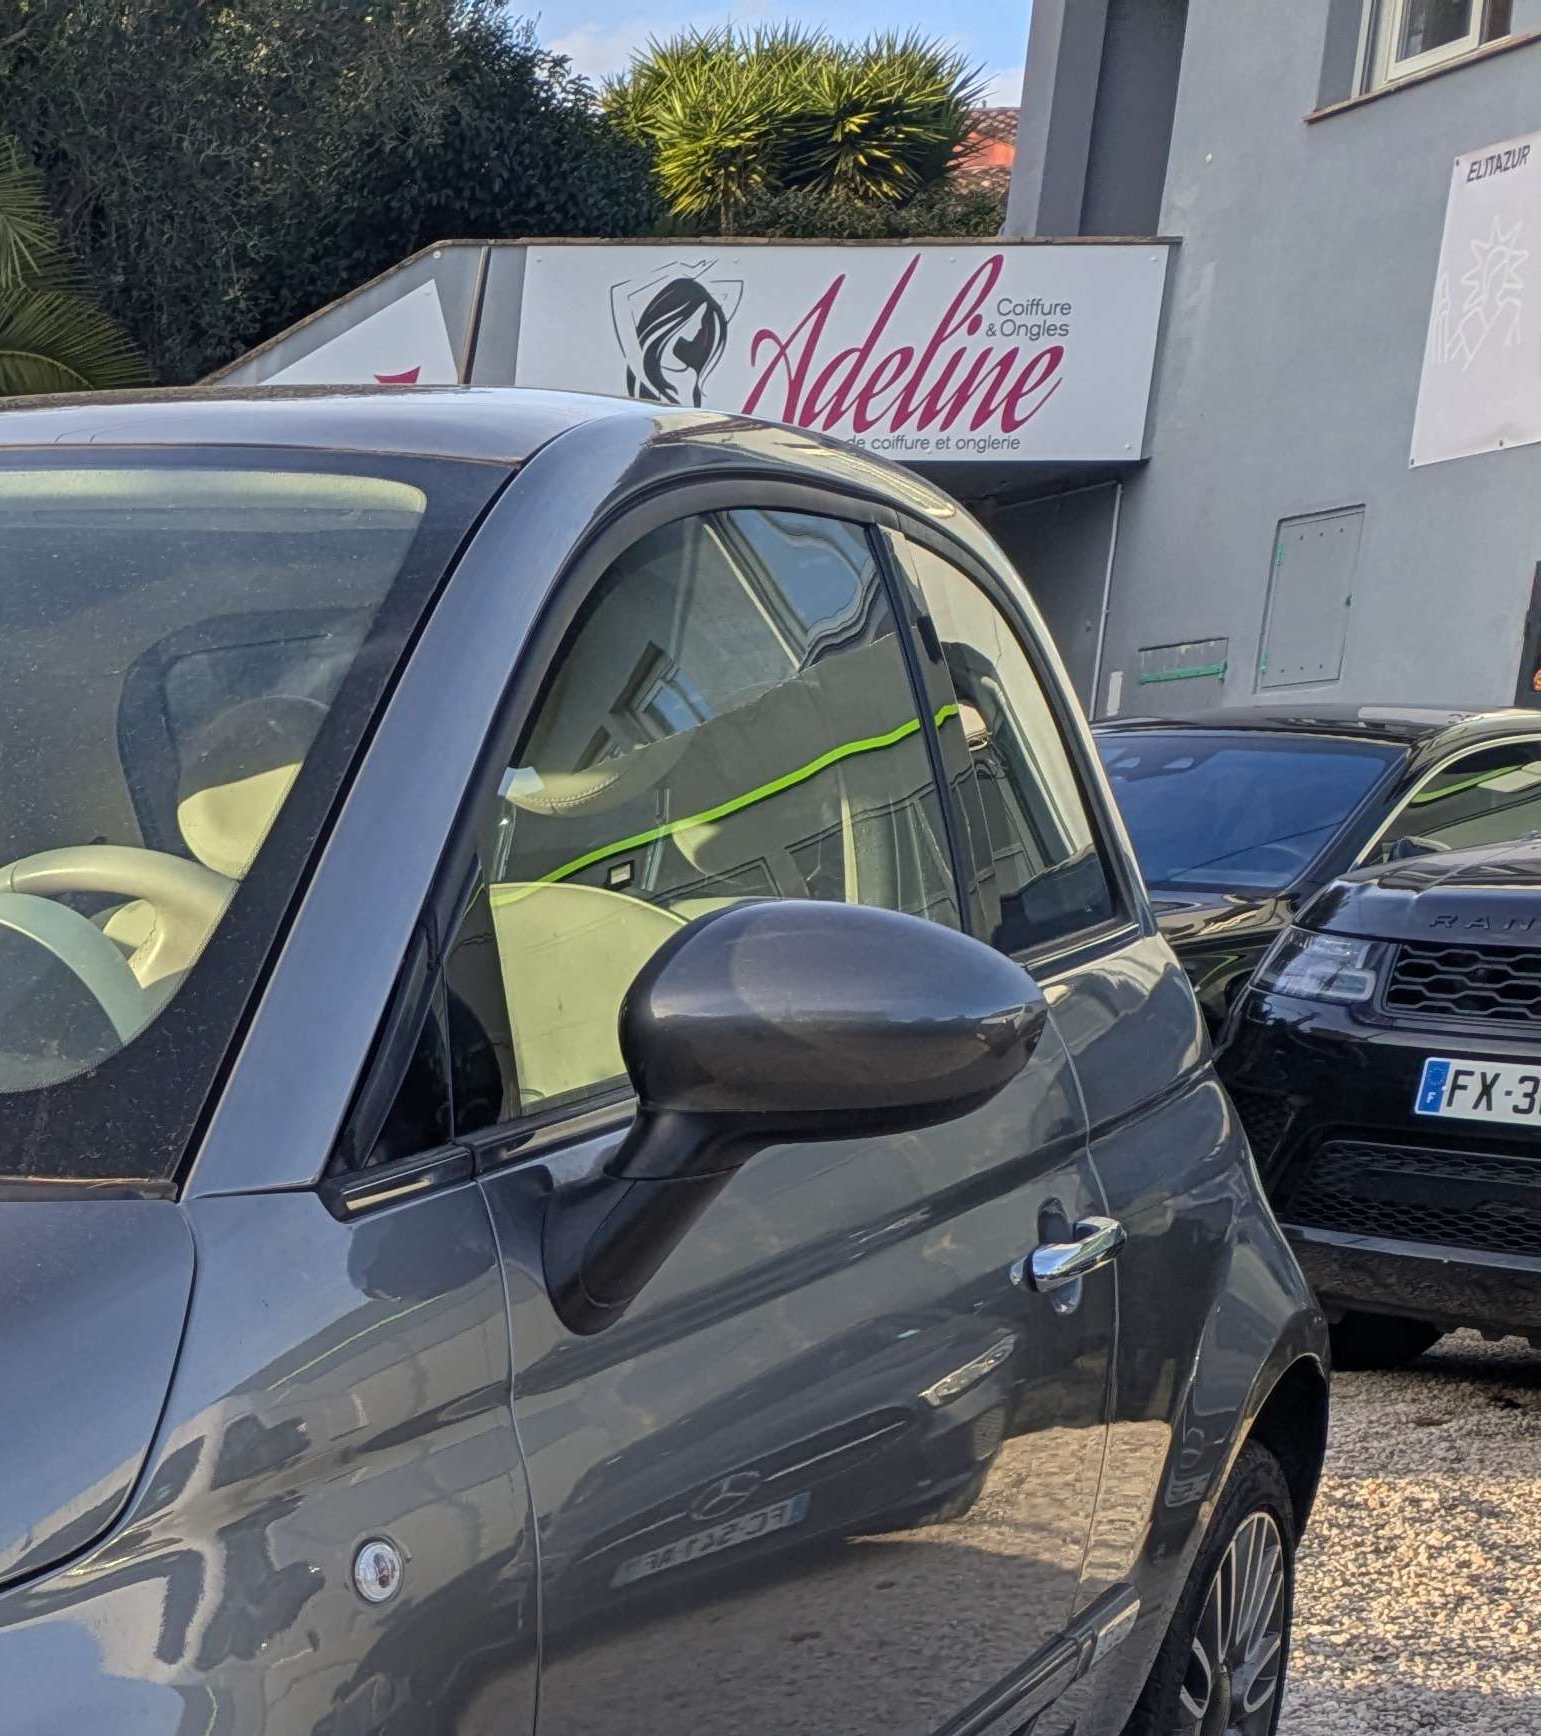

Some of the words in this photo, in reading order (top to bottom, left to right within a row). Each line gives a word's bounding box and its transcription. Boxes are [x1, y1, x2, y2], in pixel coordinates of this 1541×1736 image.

[1465, 144, 1531, 183] ELITAZUR
[997, 297, 1072, 316] Coiffure
[1000, 318, 1070, 341] Ongles
[741, 252, 1064, 434] Adeline
[871, 434, 930, 450] coiffure
[935, 435, 951, 450] et
[955, 434, 1021, 454] onglerie
[1426, 1091, 1437, 1104] F
[1445, 1068, 1541, 1115] FX-3
